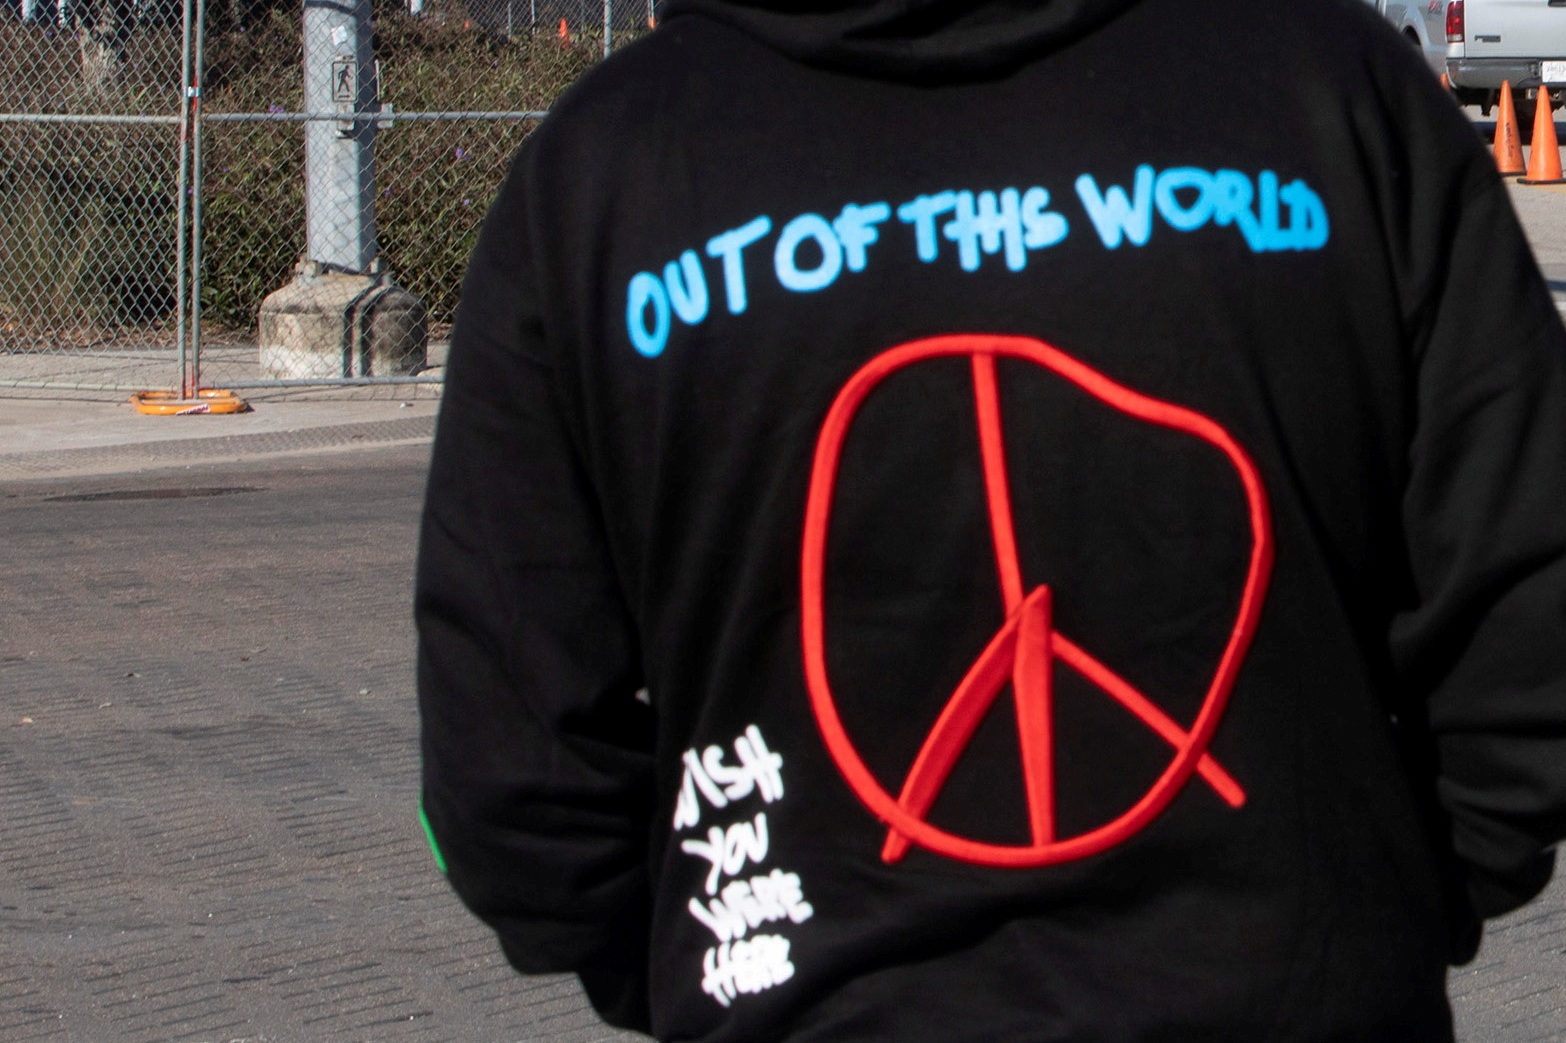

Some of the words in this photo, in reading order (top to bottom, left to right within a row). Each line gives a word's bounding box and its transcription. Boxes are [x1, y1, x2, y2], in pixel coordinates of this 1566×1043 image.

[627, 215, 771, 357] OUT
[773, 202, 890, 293] OF
[899, 186, 1068, 272] THIS
[1075, 164, 1329, 251] WORLD
[681, 812, 768, 896] YOU
